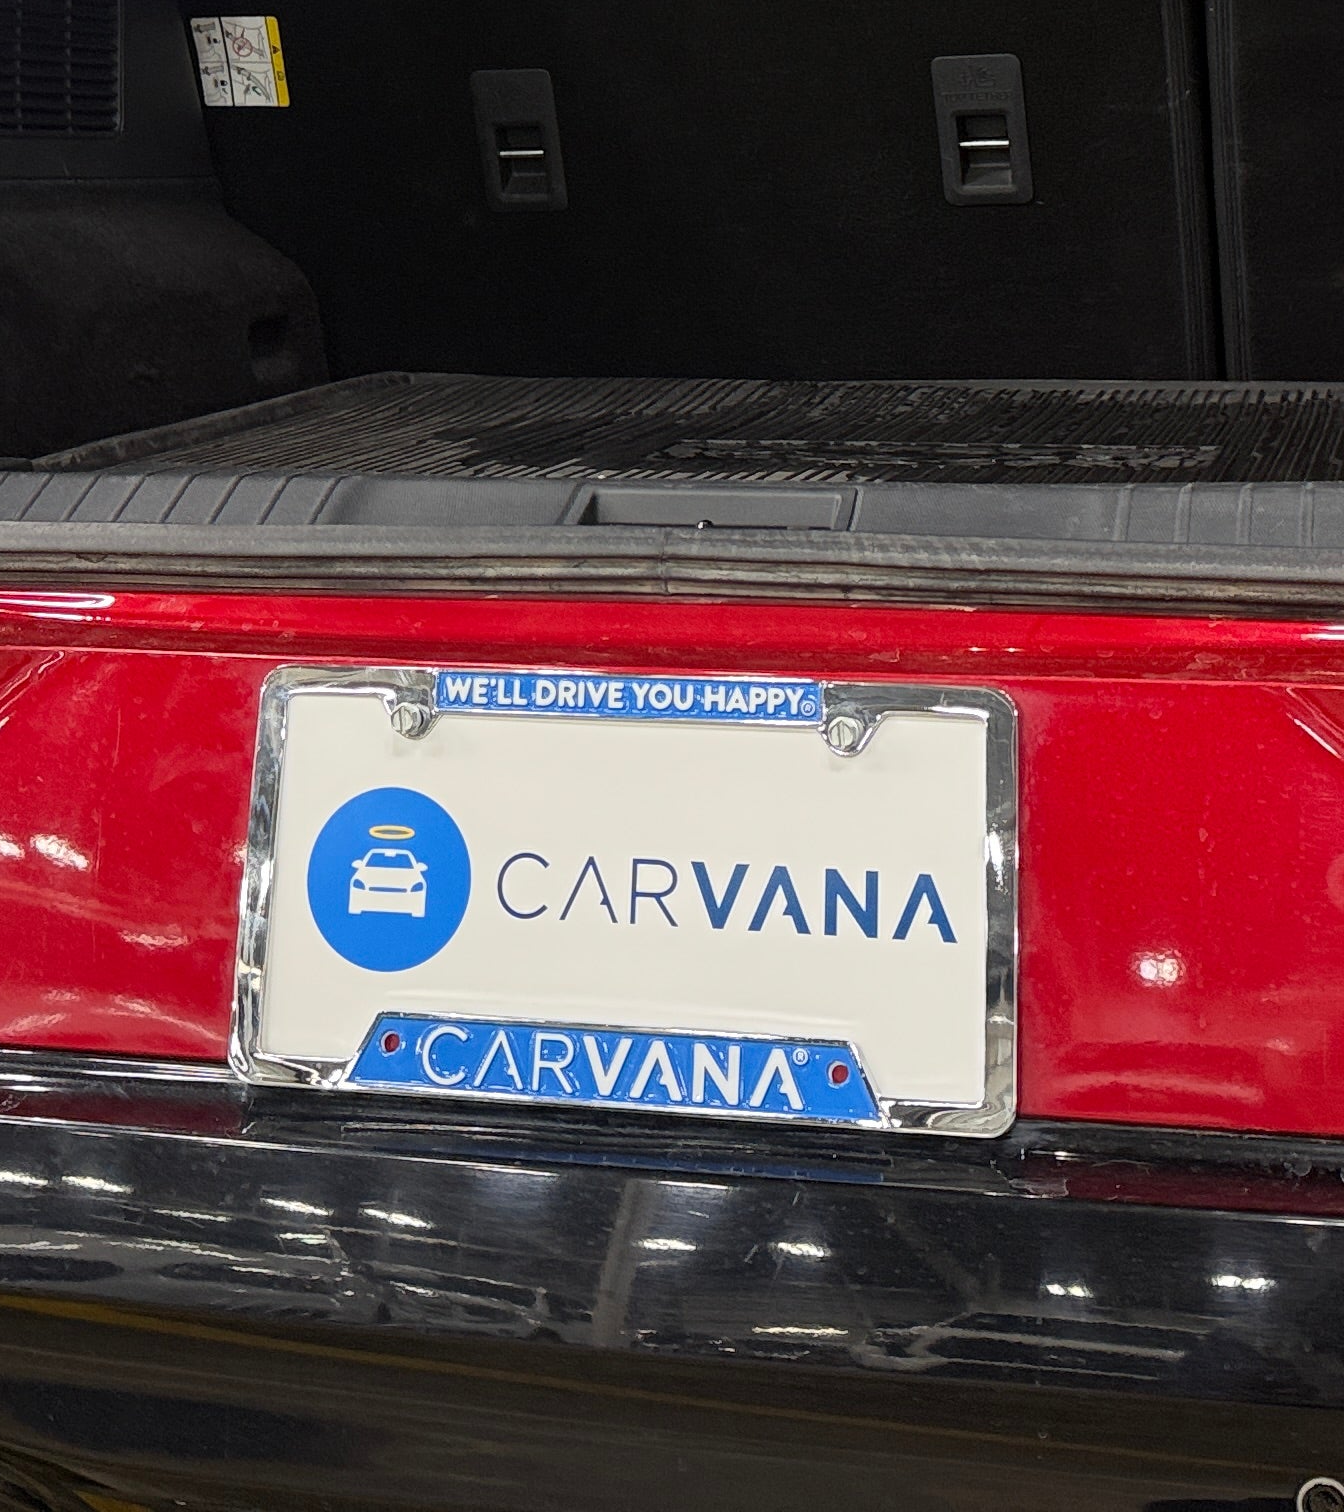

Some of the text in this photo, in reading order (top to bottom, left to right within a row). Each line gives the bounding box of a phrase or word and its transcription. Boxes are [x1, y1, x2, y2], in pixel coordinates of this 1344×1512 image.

[445, 676, 528, 707] WE'LL
[534, 679, 624, 710] DRIVE
[632, 682, 695, 712] YOU
[497, 852, 958, 944] CARVANA
